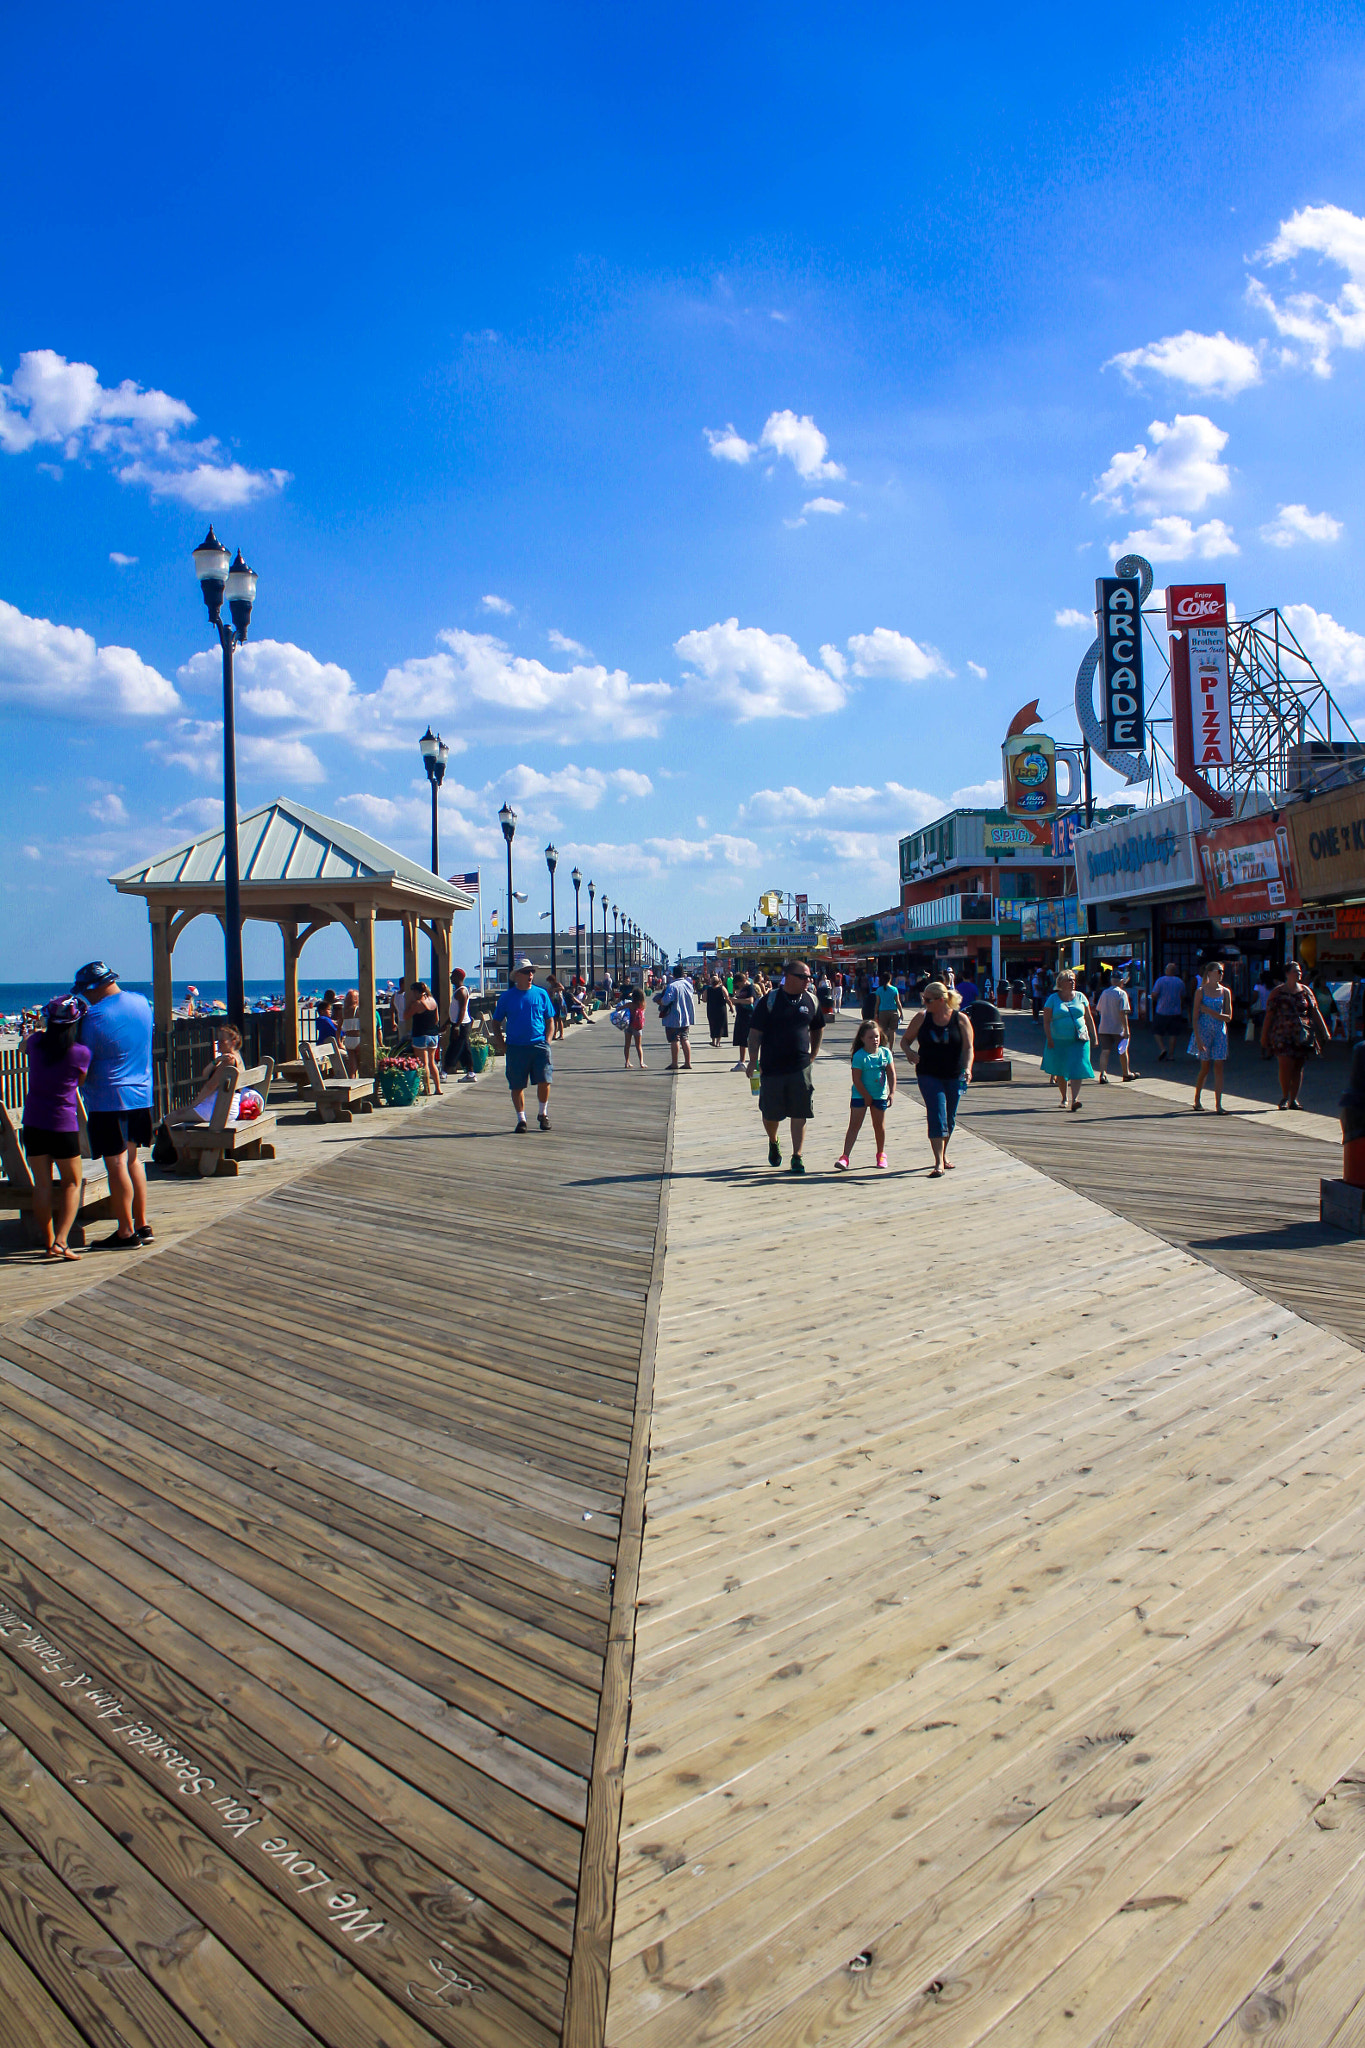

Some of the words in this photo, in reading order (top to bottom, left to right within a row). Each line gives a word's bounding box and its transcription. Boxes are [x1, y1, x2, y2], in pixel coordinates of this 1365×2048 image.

[1177, 597, 1222, 616] Coke
[1194, 591, 1213, 599] Enjoy
[1191, 638, 1224, 646] Brothers
[1196, 629, 1218, 637] Three
[1108, 587, 1138, 743] ARCADE
[1200, 676, 1224, 763] PIZZA
[1308, 826, 1341, 861] ONE
[1241, 862, 1267, 880] PIZZA
[1295, 921, 1335, 933] HERE
[1296, 909, 1334, 921] ATM
[18, 1635, 76, 1673] Frank
[60, 1672, 93, 1688] &
[85, 1688, 128, 1718] Ann
[112, 1721, 216, 1795] Seaside!
[211, 1796, 263, 1838] You
[261, 1837, 333, 1893] Love
[327, 1892, 386, 1943] We
